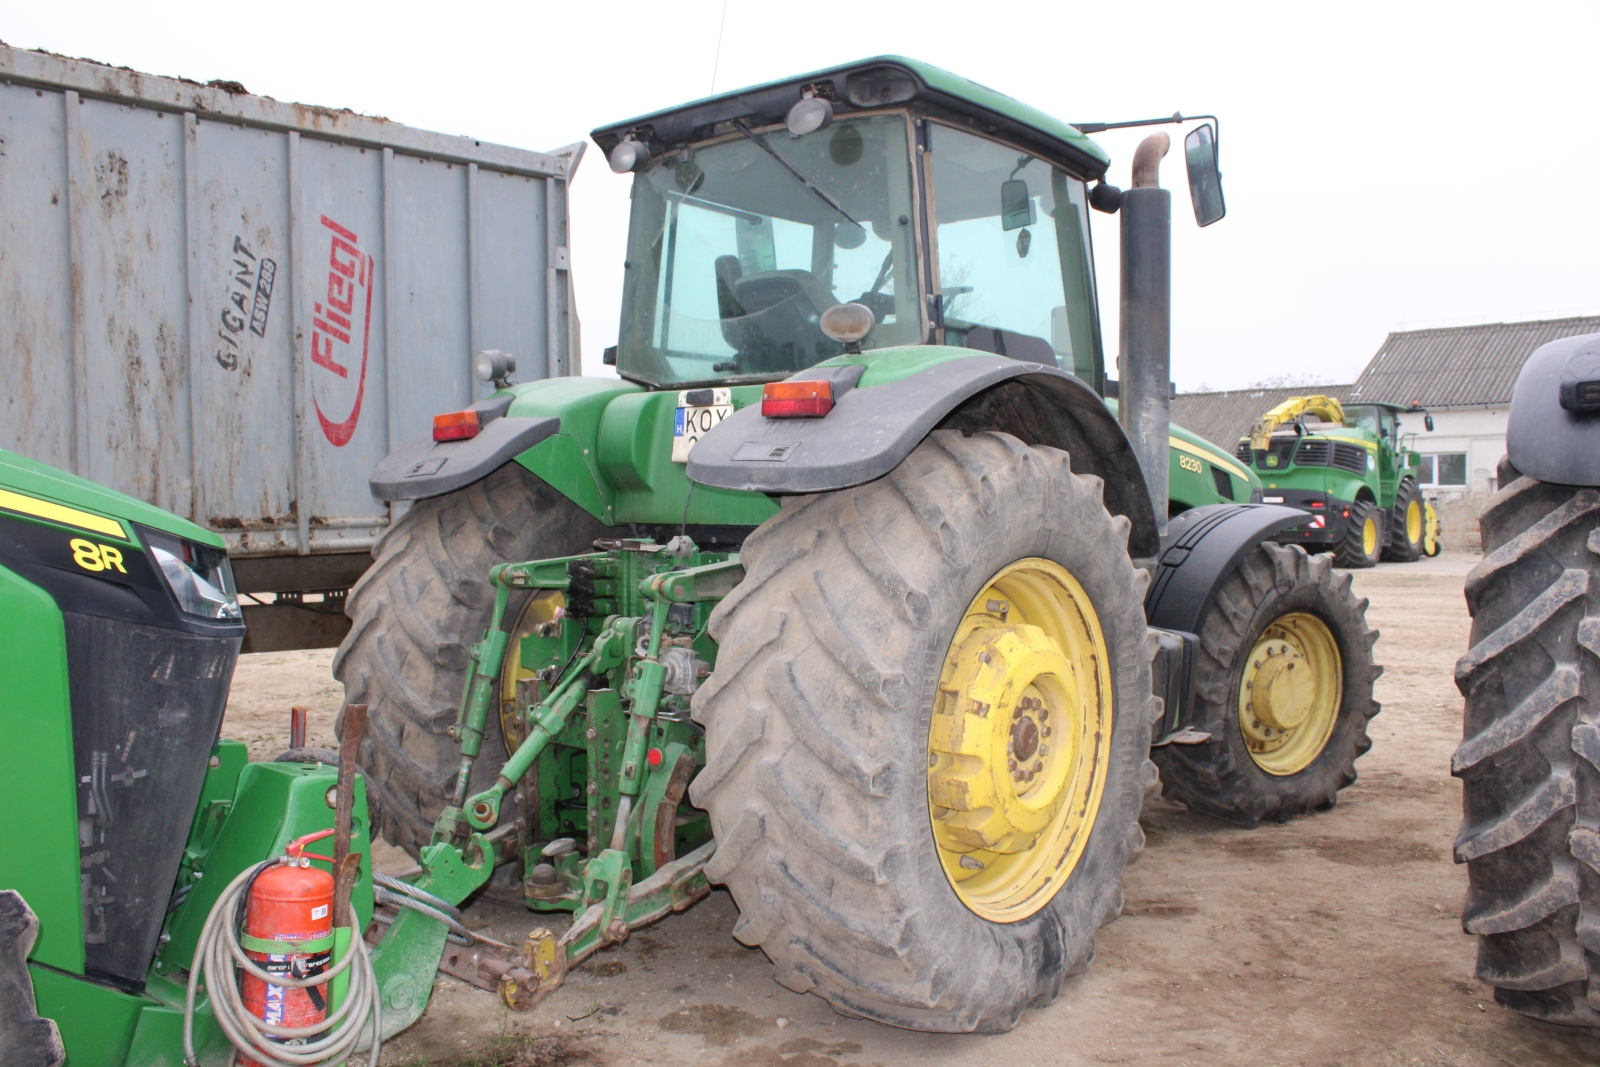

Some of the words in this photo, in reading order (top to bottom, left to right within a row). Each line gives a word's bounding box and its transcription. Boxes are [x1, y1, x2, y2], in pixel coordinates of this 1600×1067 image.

[259, 259, 275, 295] 288
[215, 235, 257, 371] GIGANT
[251, 290, 269, 334] ASW
[311, 214, 366, 379] Fliegl
[676, 424, 683, 434] H
[1179, 455, 1202, 474] 8230
[70, 538, 128, 573] 8R
